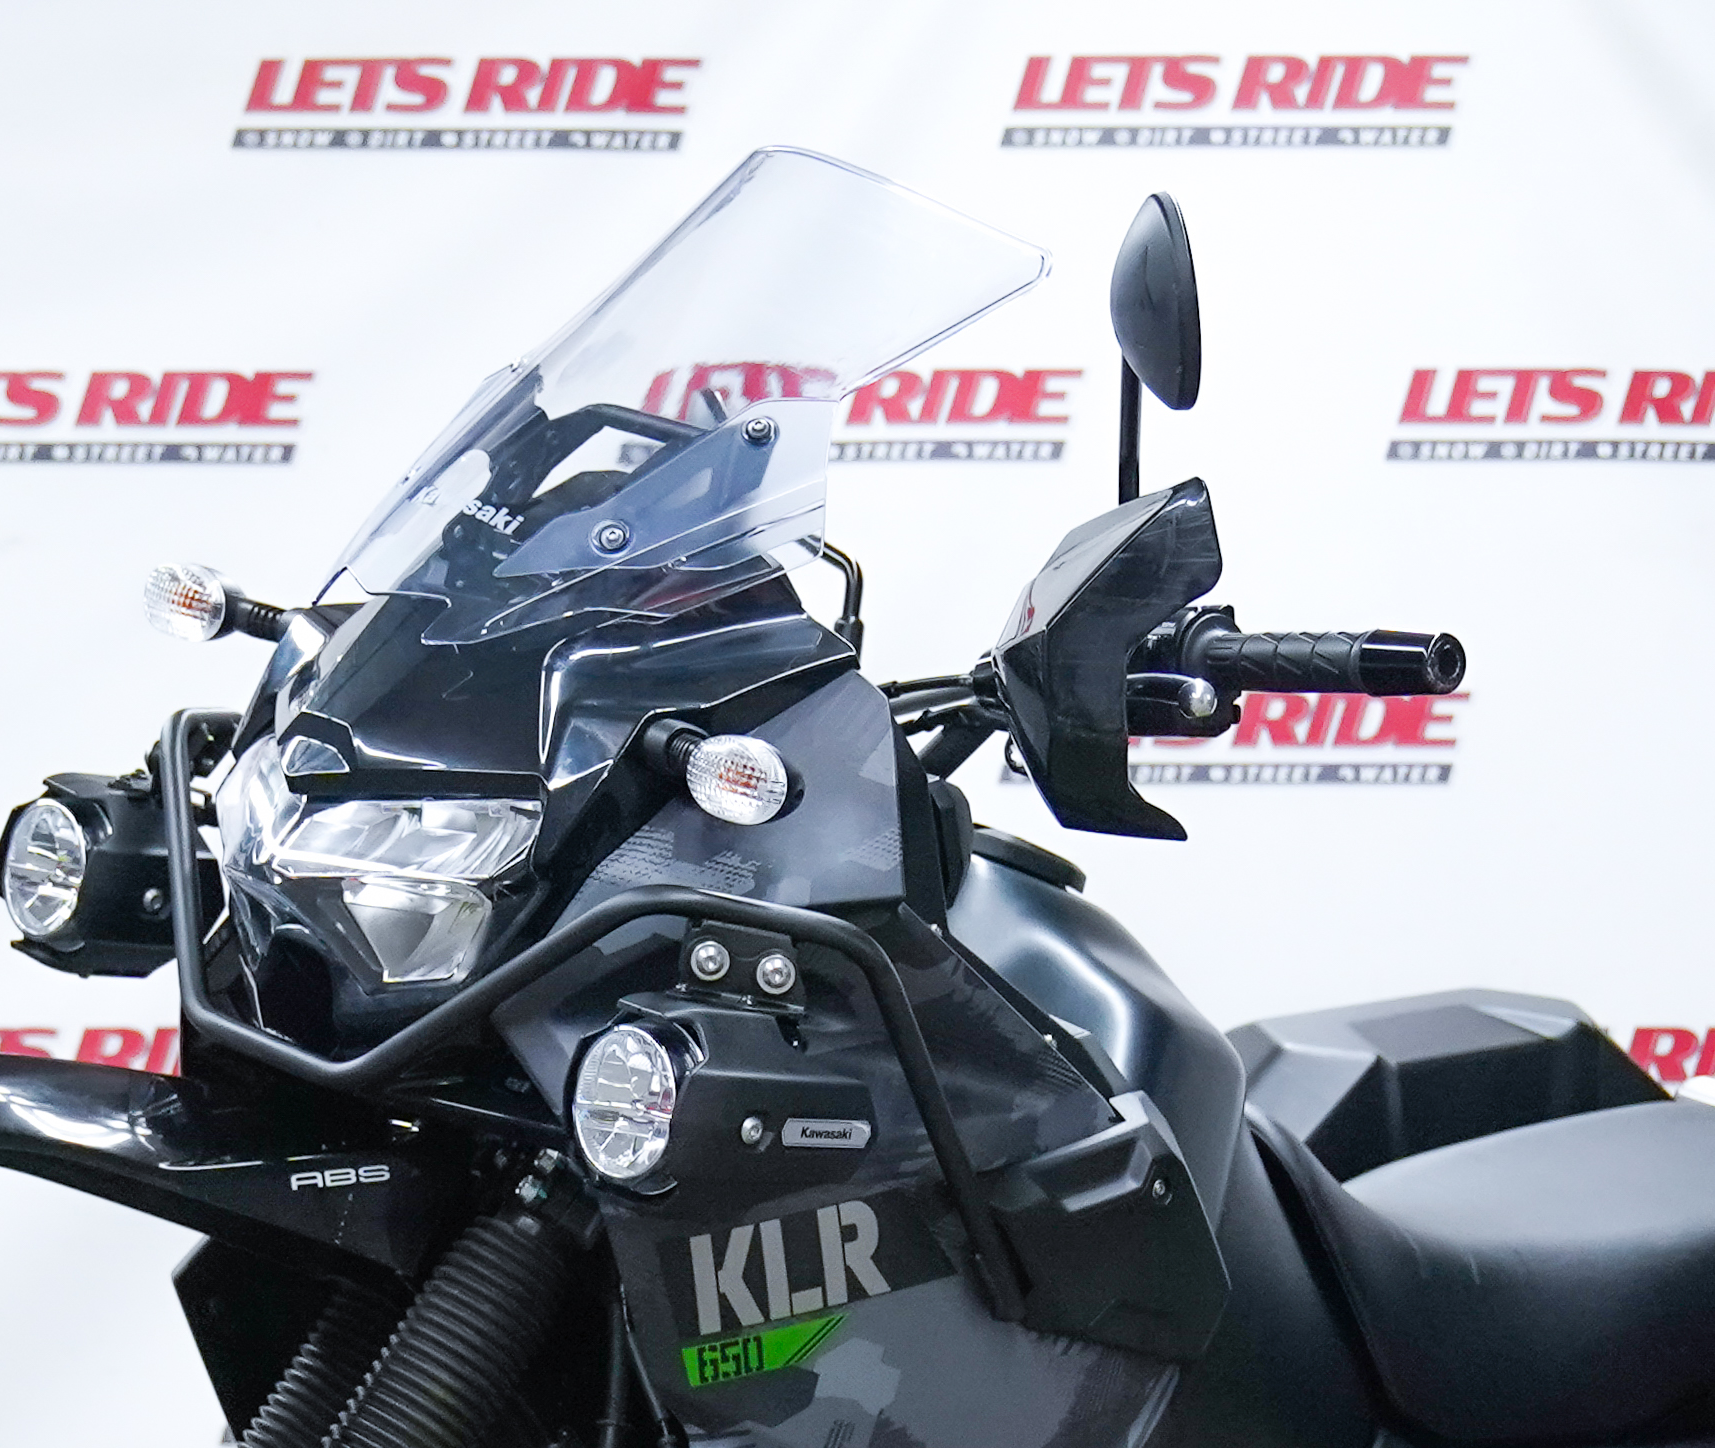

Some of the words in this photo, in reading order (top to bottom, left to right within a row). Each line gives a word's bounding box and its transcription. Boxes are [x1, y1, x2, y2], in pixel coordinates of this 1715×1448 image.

[247, 58, 451, 111] LETS
[466, 58, 698, 113] RIDE
[1015, 55, 1217, 109] LETS
[1235, 56, 1467, 108] RIDE
[77, 372, 311, 425] RIDE
[846, 369, 1080, 424] RIDE
[1401, 369, 1605, 422] LETS
[1233, 692, 1469, 746] RIDE
[74, 1028, 181, 1077] RI
[800, 1127, 853, 1140] Kawasaki
[290, 1165, 390, 1191] ABS
[690, 1200, 891, 1335] KLR
[697, 1335, 764, 1384] 650
